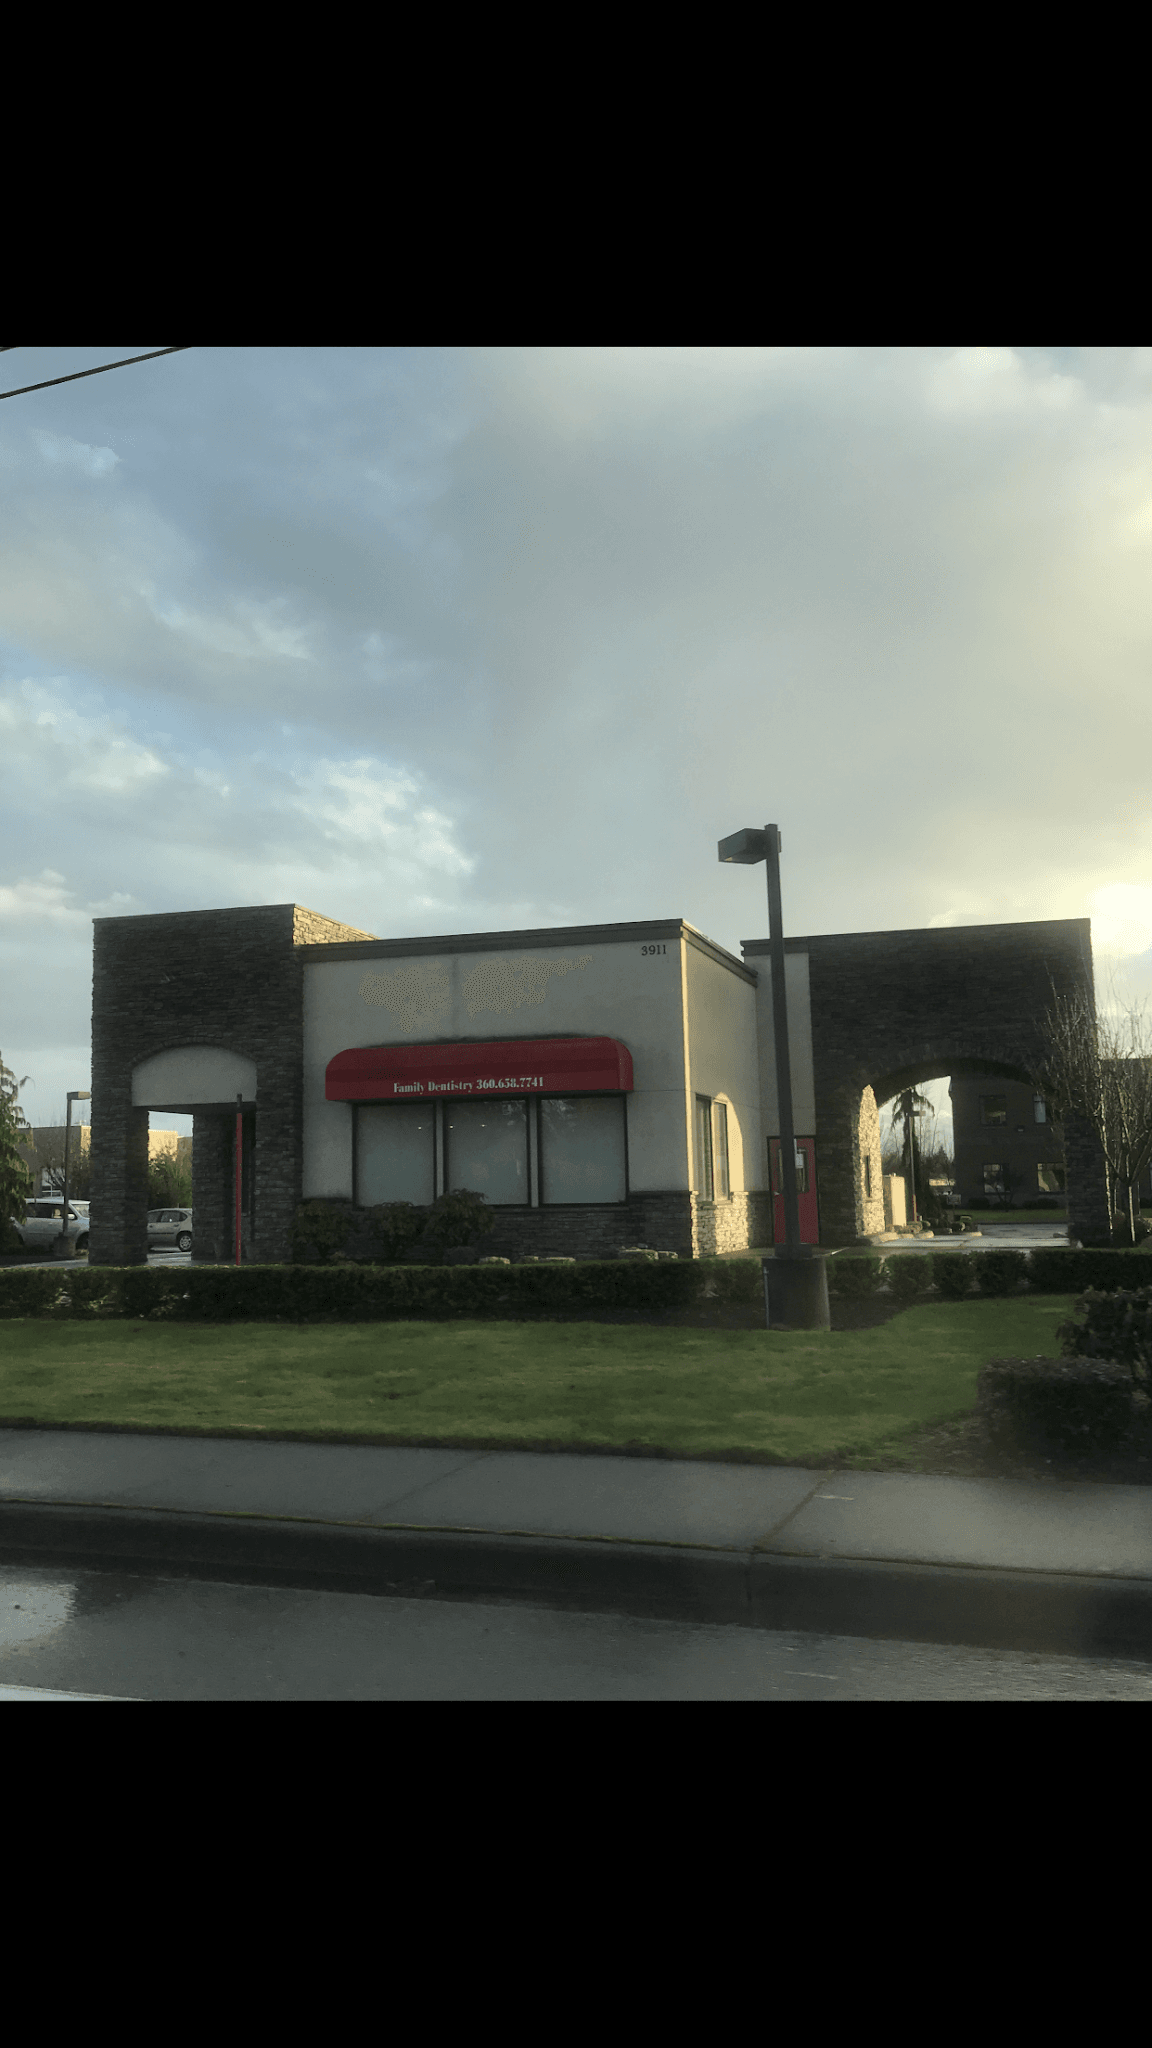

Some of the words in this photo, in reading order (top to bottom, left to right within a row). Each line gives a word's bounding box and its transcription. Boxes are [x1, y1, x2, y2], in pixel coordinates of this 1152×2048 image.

[641, 944, 667, 956] 3911
[393, 1082, 424, 1094] Family
[428, 1080, 473, 1093] Dentistry
